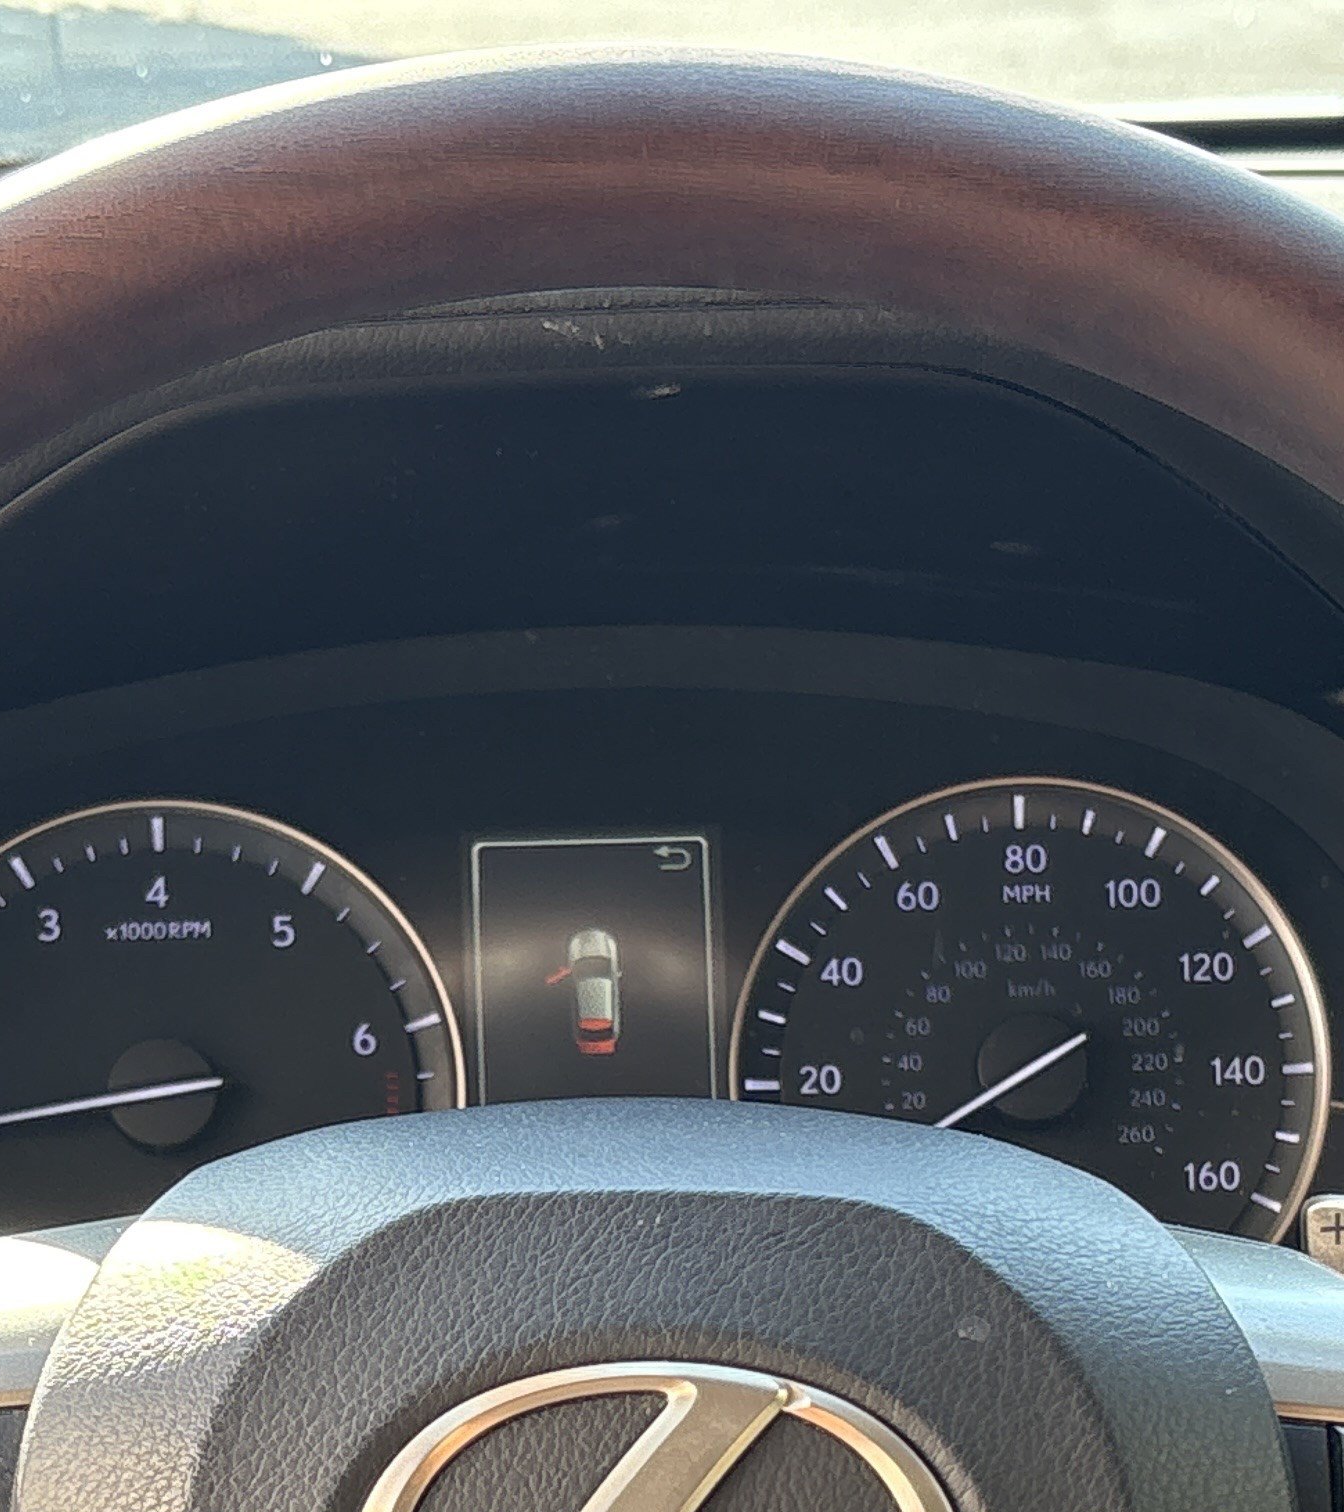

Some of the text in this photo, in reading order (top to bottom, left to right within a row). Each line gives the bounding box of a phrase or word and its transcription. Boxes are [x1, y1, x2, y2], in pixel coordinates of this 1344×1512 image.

[1005, 845, 1047, 875] 80
[144, 877, 169, 908] 4
[895, 882, 941, 912] 60
[1002, 884, 1052, 905] MPH
[1105, 879, 1162, 910] 100
[38, 909, 62, 942] 3
[272, 914, 297, 948] 5
[995, 943, 1028, 962] 120
[1040, 943, 1072, 962] 140
[820, 957, 864, 988] 40
[955, 961, 988, 980] 100
[1078, 961, 1112, 979] 160
[1180, 953, 1235, 983] 120
[925, 985, 952, 1003] 80
[1108, 985, 1141, 1005] 180
[905, 1017, 931, 1037] 60
[1122, 1017, 1160, 1037] 200
[353, 1023, 376, 1055] 6
[897, 1053, 923, 1072] 40
[1131, 1052, 1169, 1072] 220
[1211, 1056, 1266, 1087] 140
[800, 1066, 843, 1096] 20
[901, 1091, 927, 1110] 20
[1129, 1089, 1166, 1108] 240
[1117, 1124, 1156, 1143] 260
[1184, 1161, 1241, 1192] 160
